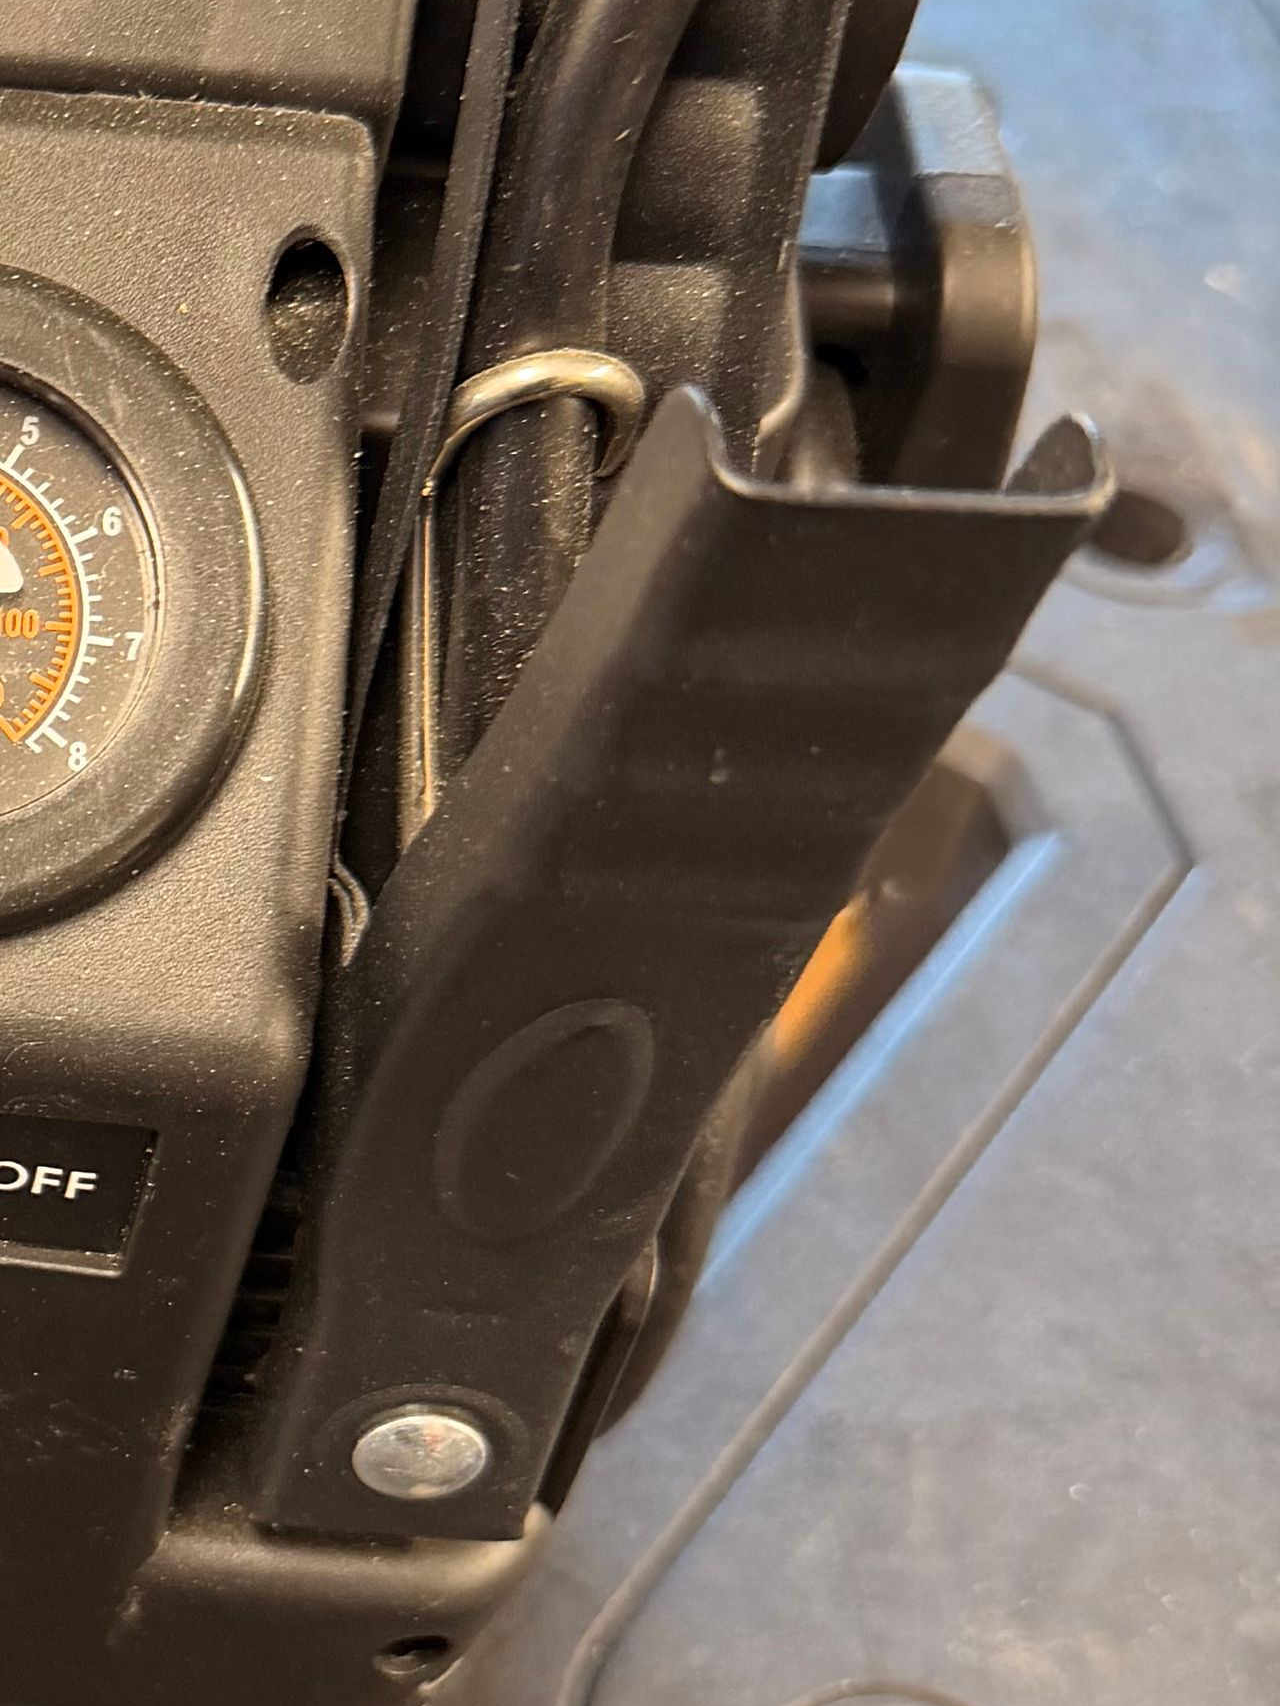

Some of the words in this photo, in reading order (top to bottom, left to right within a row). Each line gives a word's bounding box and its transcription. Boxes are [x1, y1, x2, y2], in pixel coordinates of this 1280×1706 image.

[20, 416, 40, 444] 5
[102, 506, 122, 537] 6
[125, 631, 144, 662] 7
[68, 741, 88, 772] 8
